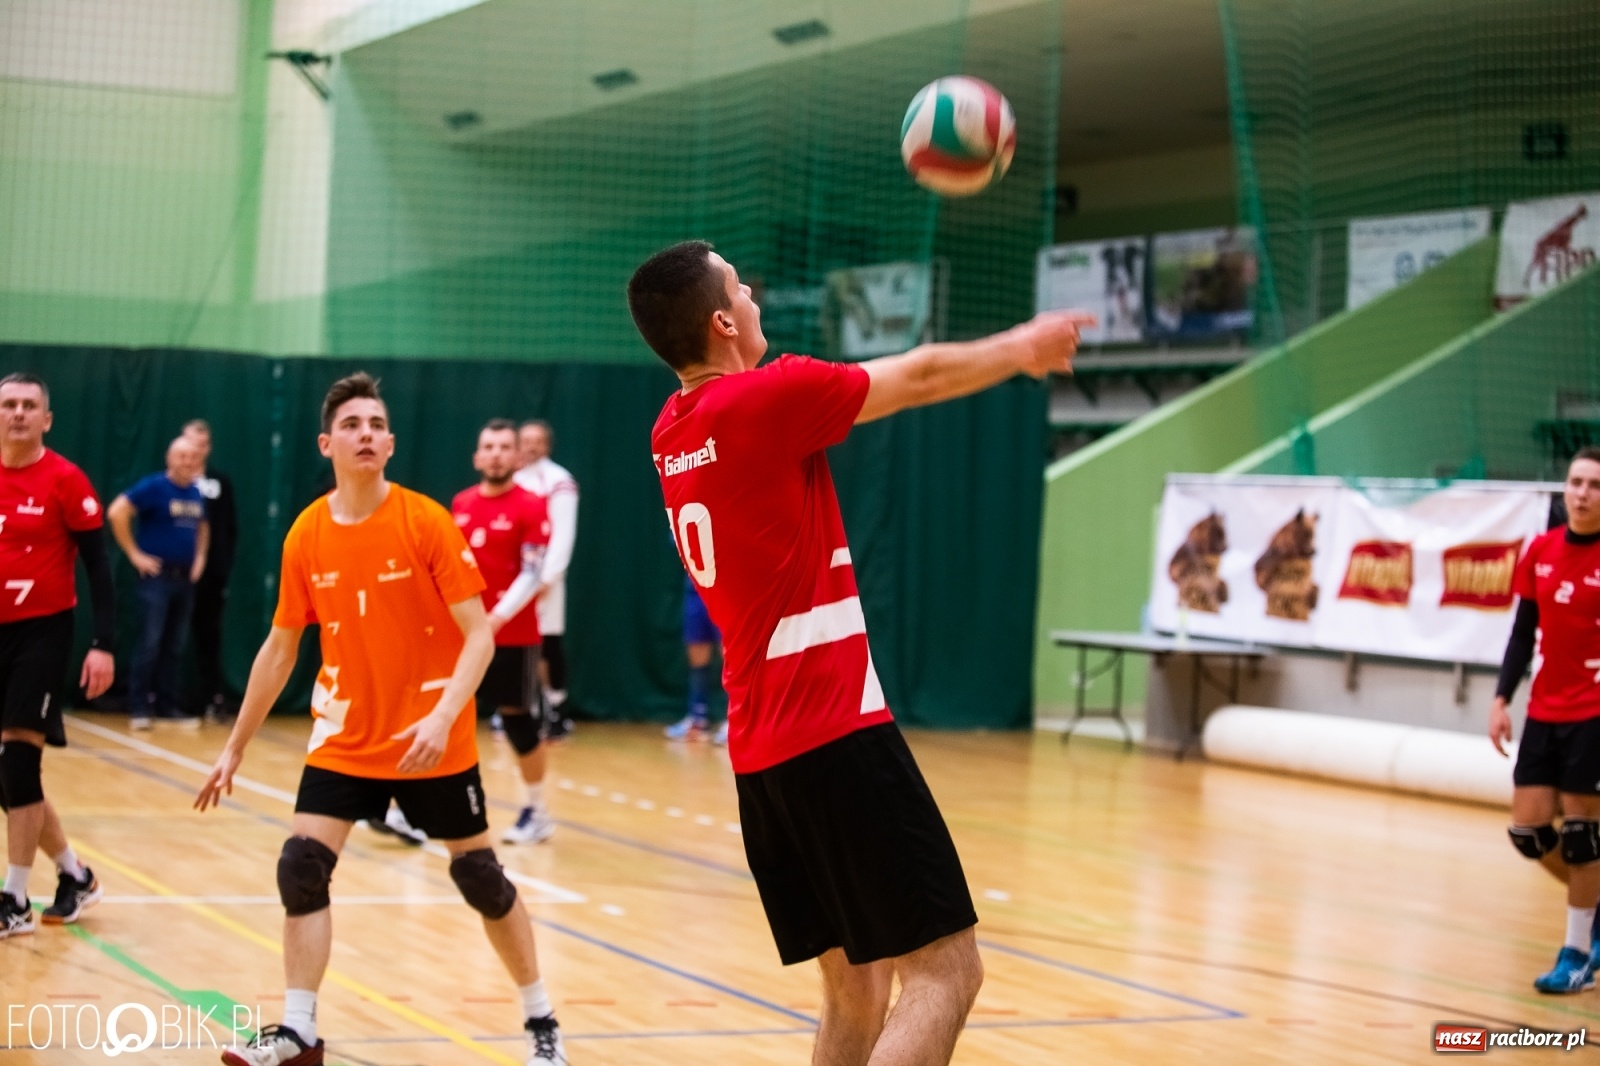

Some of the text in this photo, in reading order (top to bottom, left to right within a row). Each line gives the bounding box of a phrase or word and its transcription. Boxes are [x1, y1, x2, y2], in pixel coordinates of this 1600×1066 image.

[664, 436, 718, 477] Galmet
[356, 589, 367, 617] 1
[1553, 580, 1575, 604] 2
